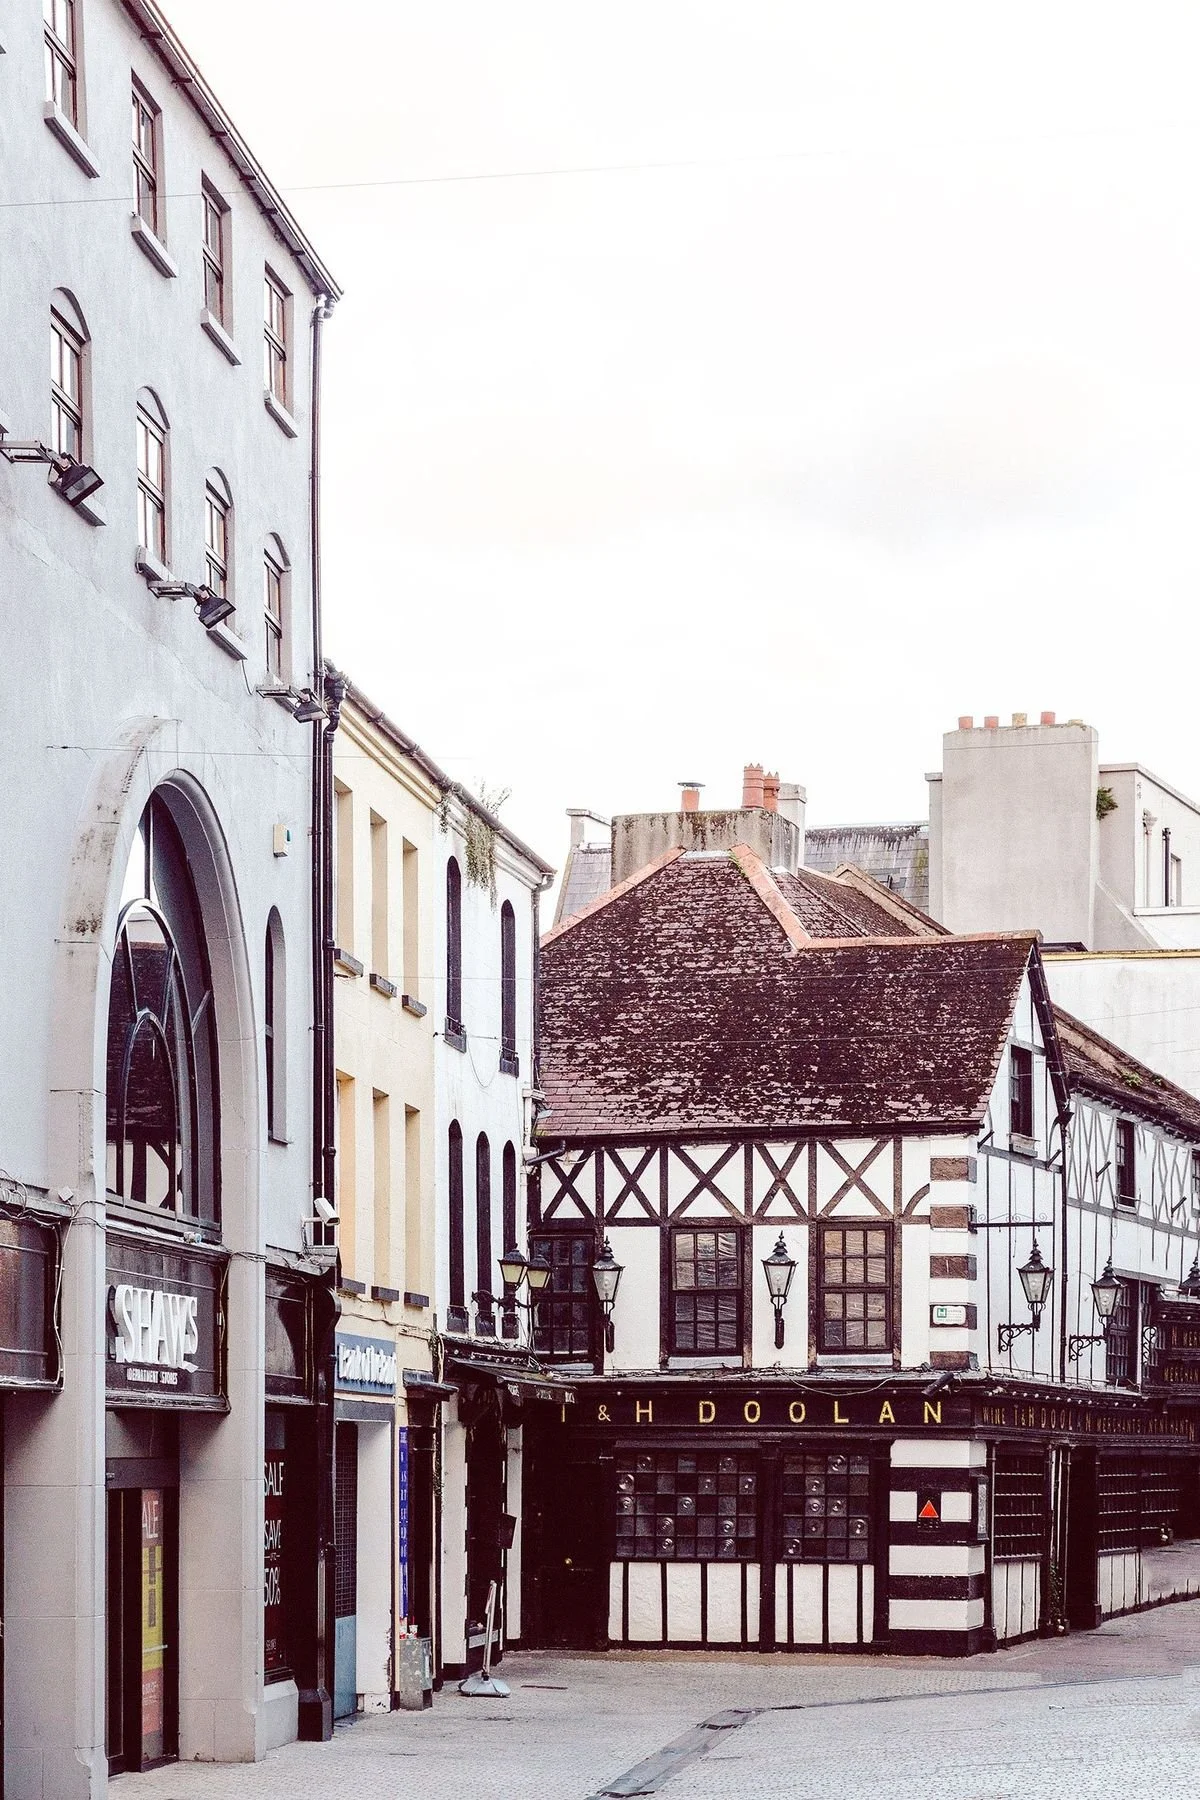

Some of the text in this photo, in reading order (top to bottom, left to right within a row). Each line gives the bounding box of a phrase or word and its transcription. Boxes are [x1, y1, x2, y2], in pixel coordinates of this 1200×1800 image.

[114, 1285, 198, 1369] SHAWS
[160, 1372, 178, 1385] STORES
[699, 1400, 942, 1424] DOOLAN
[264, 1462, 284, 1496] SALE
[142, 1500, 159, 1539] ALE
[264, 1567, 280, 1606] 50%
